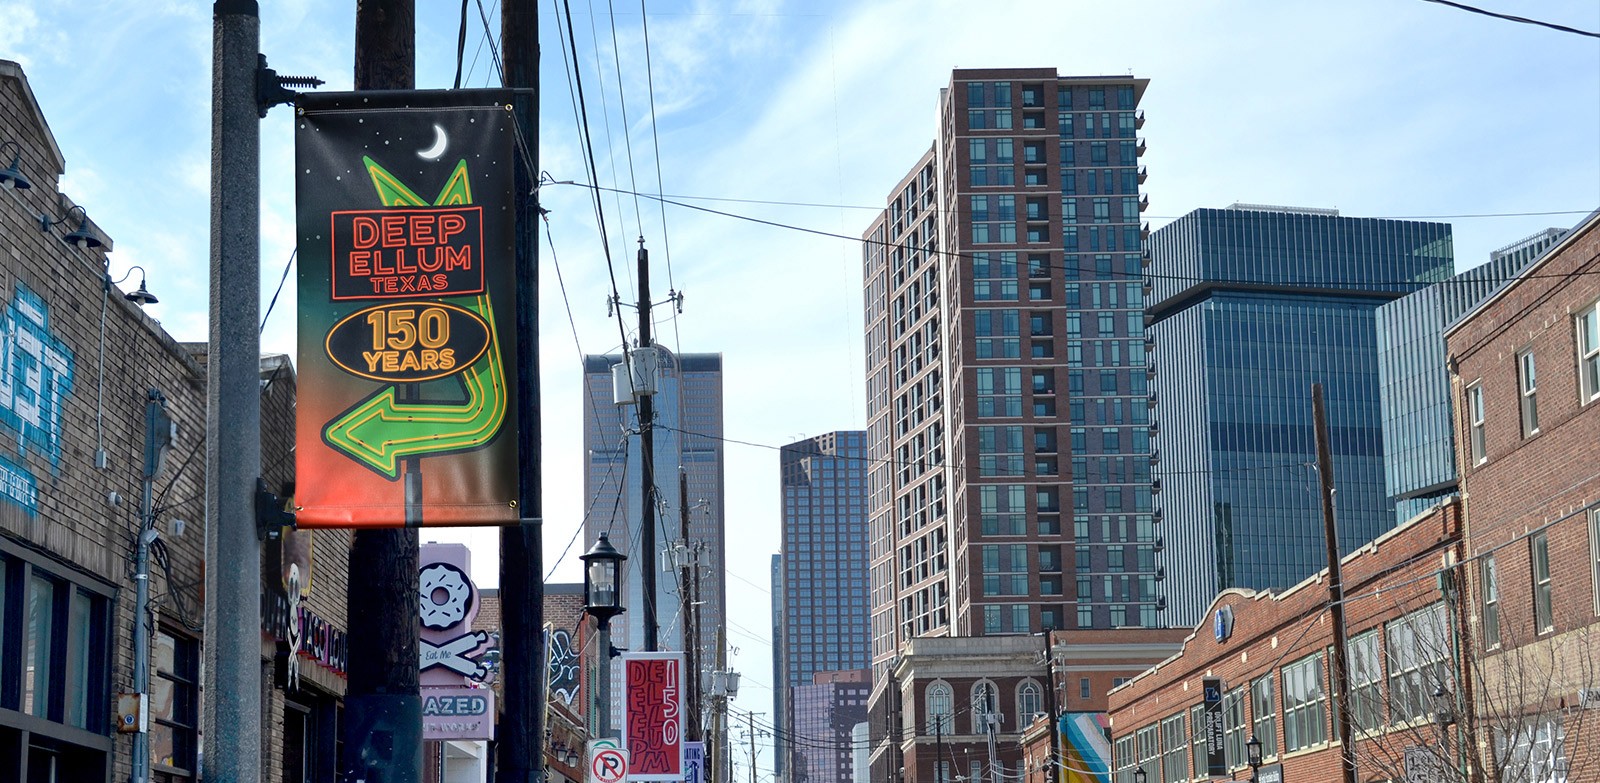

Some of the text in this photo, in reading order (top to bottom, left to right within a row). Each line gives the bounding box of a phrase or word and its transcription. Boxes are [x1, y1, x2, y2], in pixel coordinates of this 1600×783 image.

[352, 215, 467, 249] DEEP
[349, 245, 473, 277] ELLUM
[370, 274, 449, 294] TEXAS
[366, 308, 451, 352] 150
[362, 348, 456, 373] YEARS
[425, 651, 452, 661] Eat Me
[423, 698, 485, 715] AZED
[662, 660, 679, 746] 150
